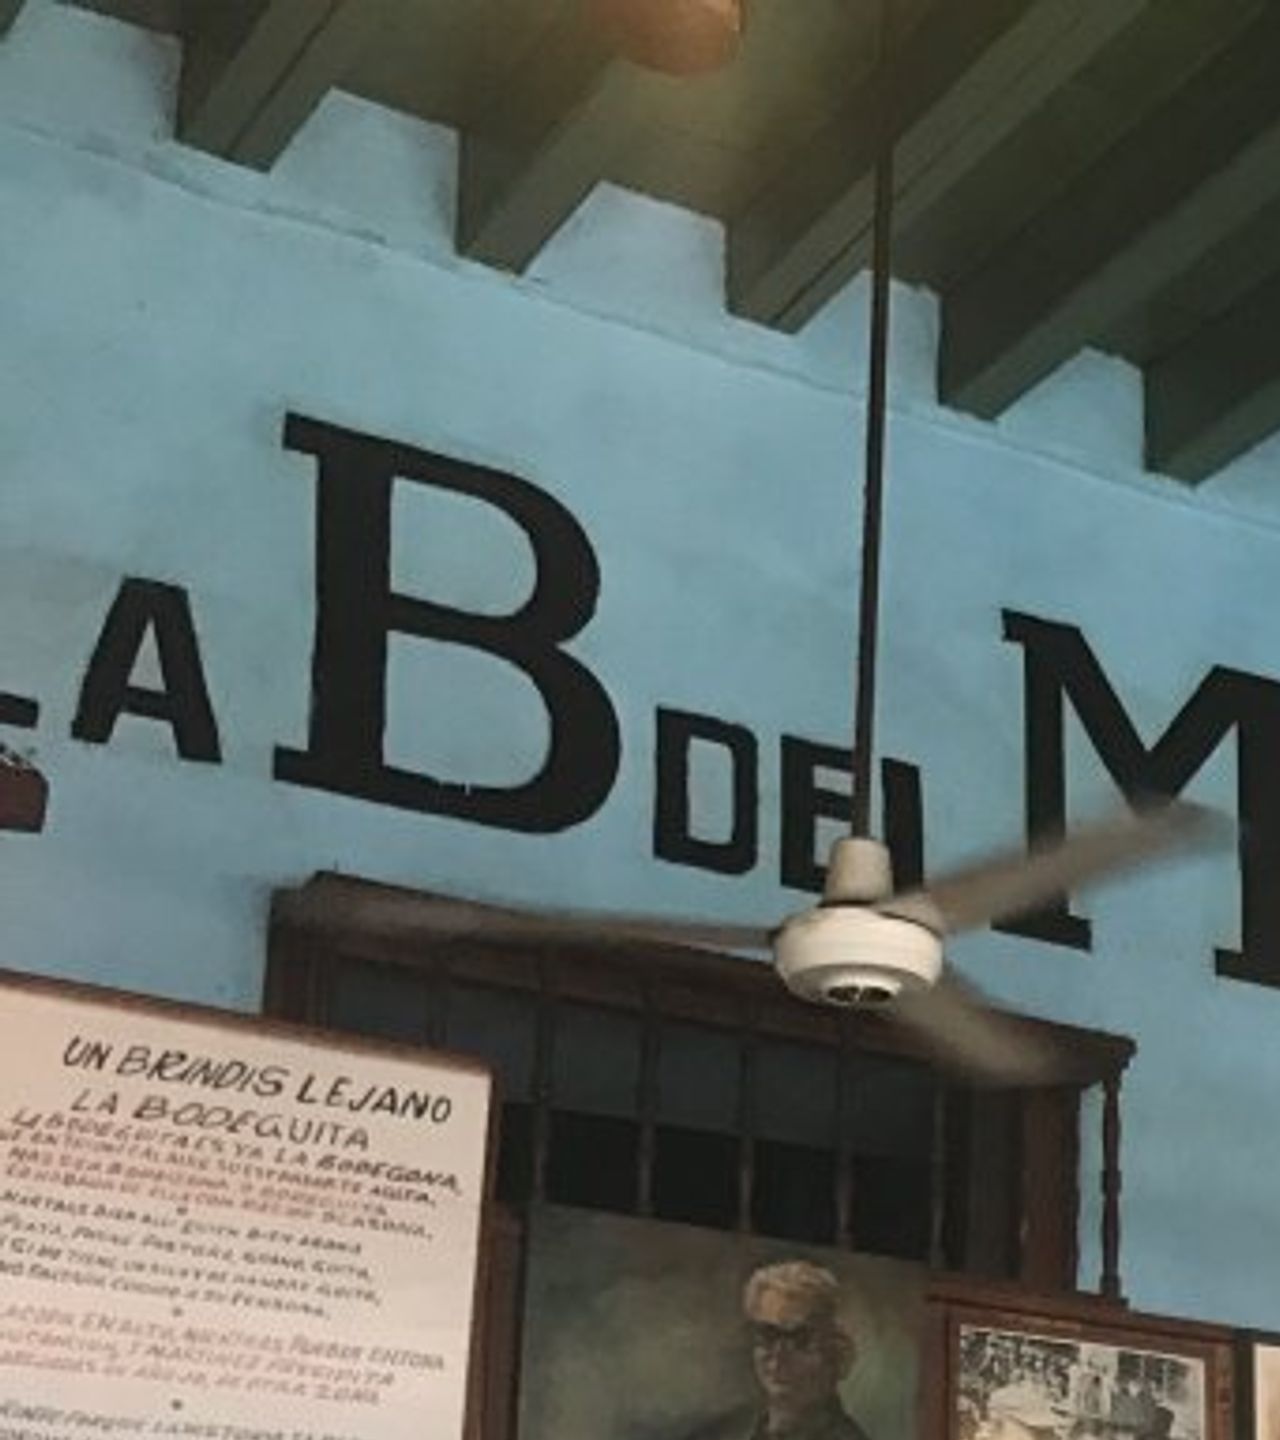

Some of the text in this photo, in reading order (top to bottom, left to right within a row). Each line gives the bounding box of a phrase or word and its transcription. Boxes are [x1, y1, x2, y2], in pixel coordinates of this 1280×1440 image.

[272, 411, 622, 834] B
[62, 1036, 454, 1124] UN BRINDIS LEJANO
[71, 1088, 118, 1115] LA
[133, 1095, 371, 1152] BODEGUITA
